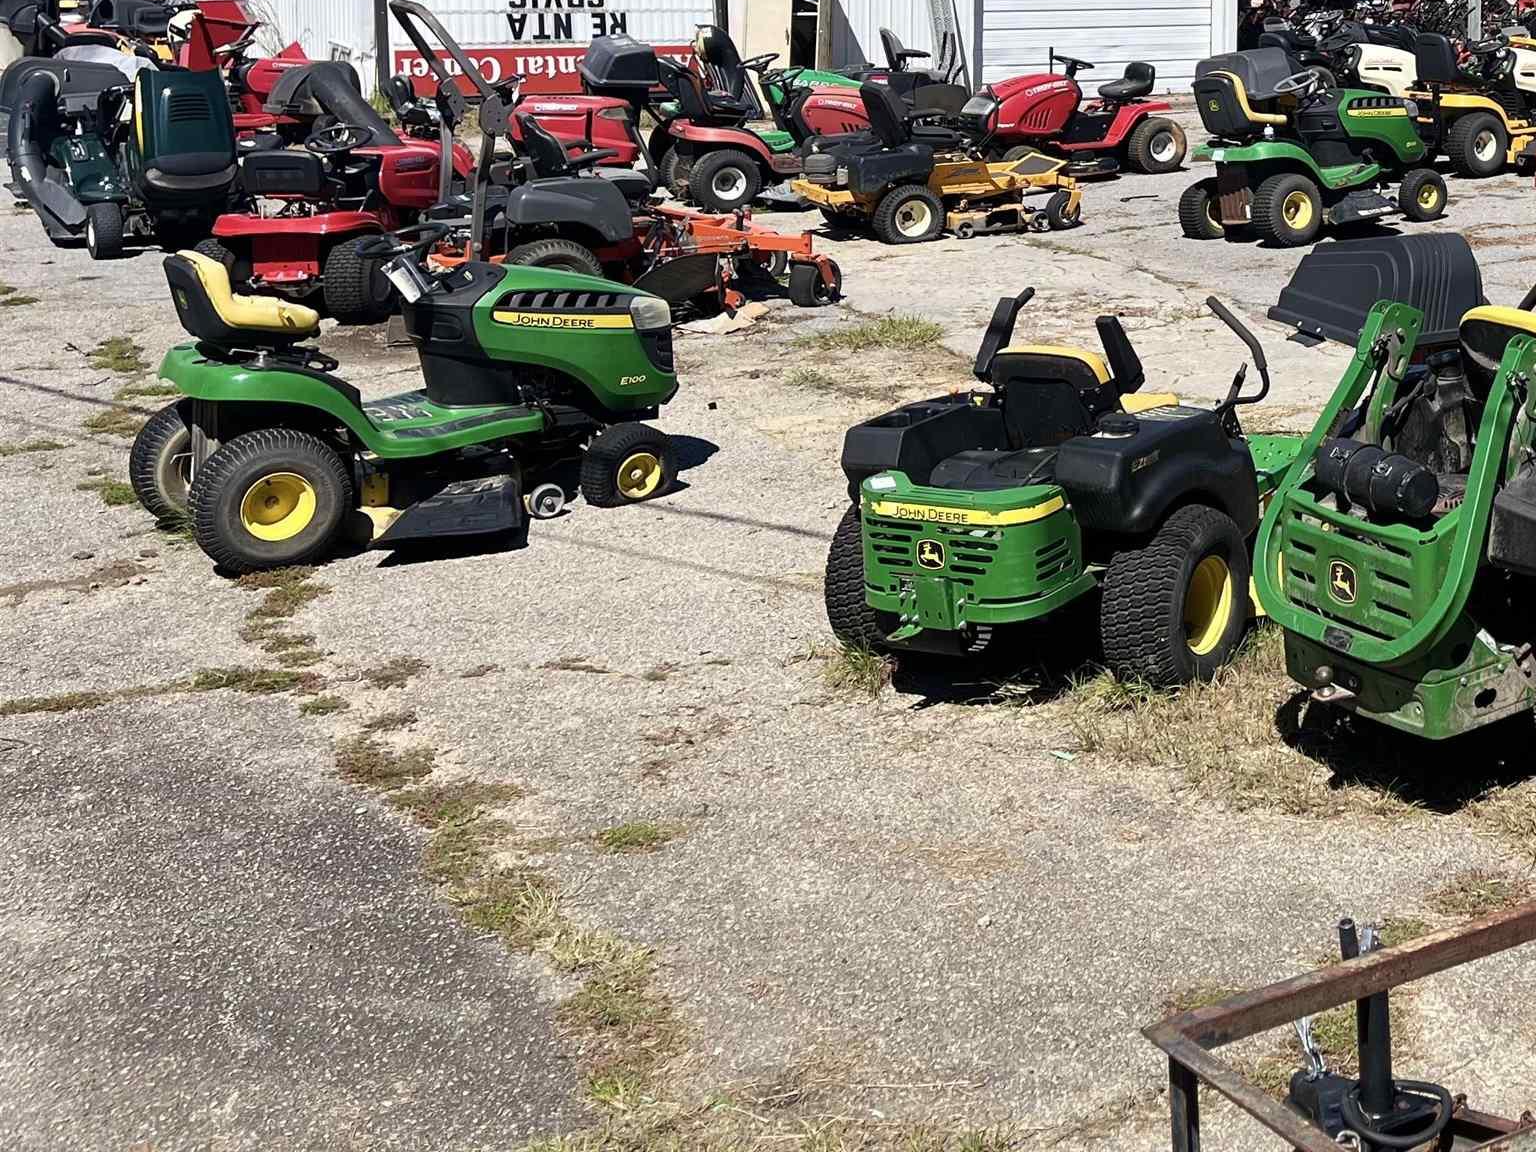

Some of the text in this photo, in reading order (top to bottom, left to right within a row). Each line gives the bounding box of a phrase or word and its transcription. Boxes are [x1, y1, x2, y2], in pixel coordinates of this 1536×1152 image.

[507, 13, 573, 41] NTA
[513, 314, 594, 327] JOHN DEERE
[620, 375, 647, 385] E100
[893, 506, 969, 523] JOHN DEERE
